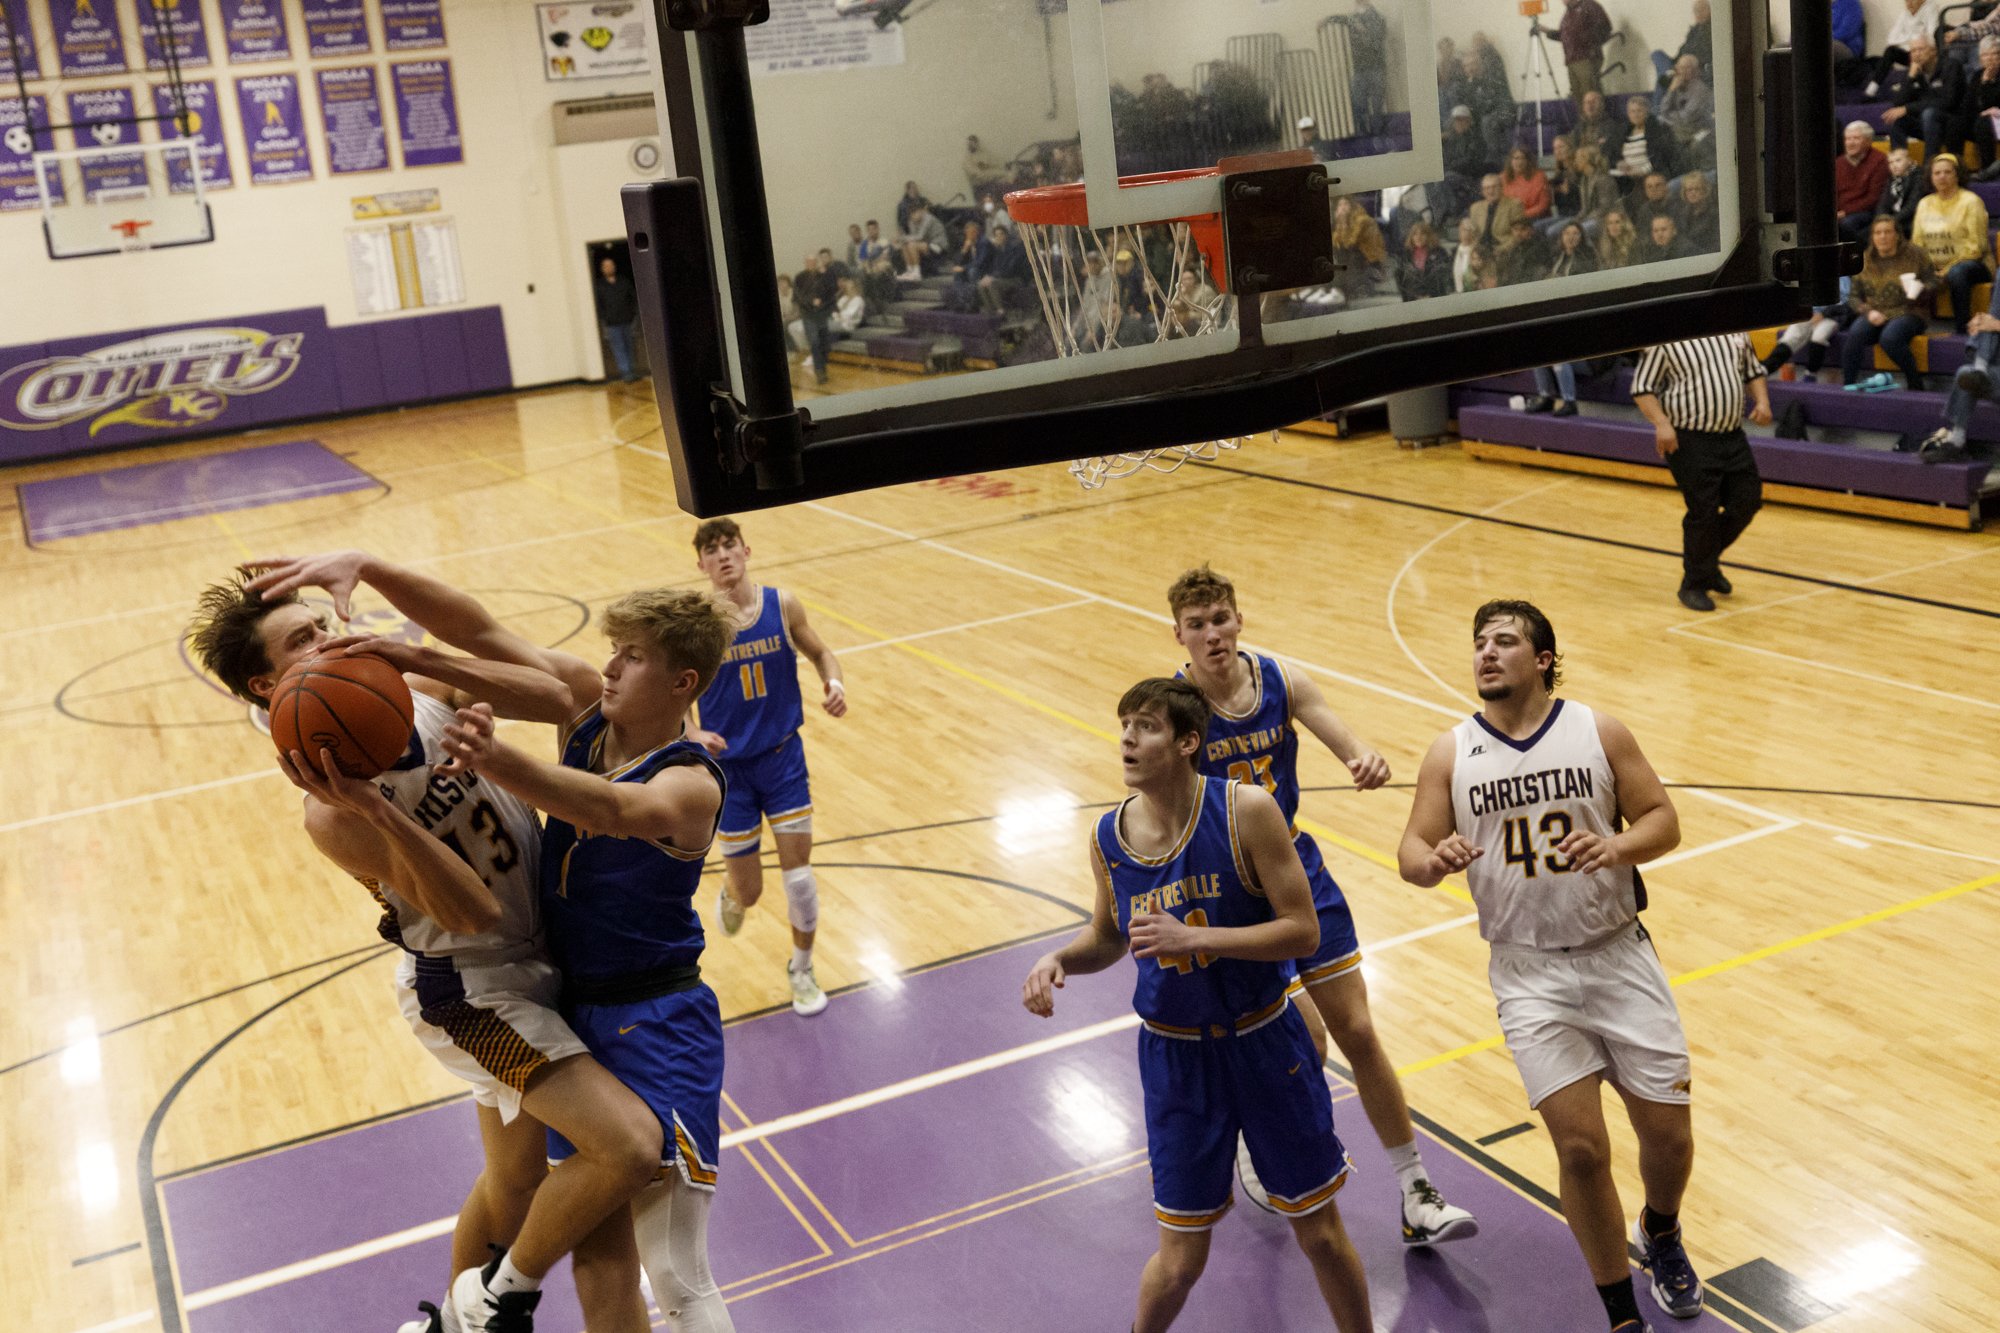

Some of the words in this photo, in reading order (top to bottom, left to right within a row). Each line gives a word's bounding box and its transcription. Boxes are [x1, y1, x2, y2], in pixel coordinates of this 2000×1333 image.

[721, 634, 782, 665] NTREVILLE
[739, 661, 768, 701] 11
[1469, 767, 1594, 817] CHRISTIAN
[1503, 809, 1574, 879] 43
